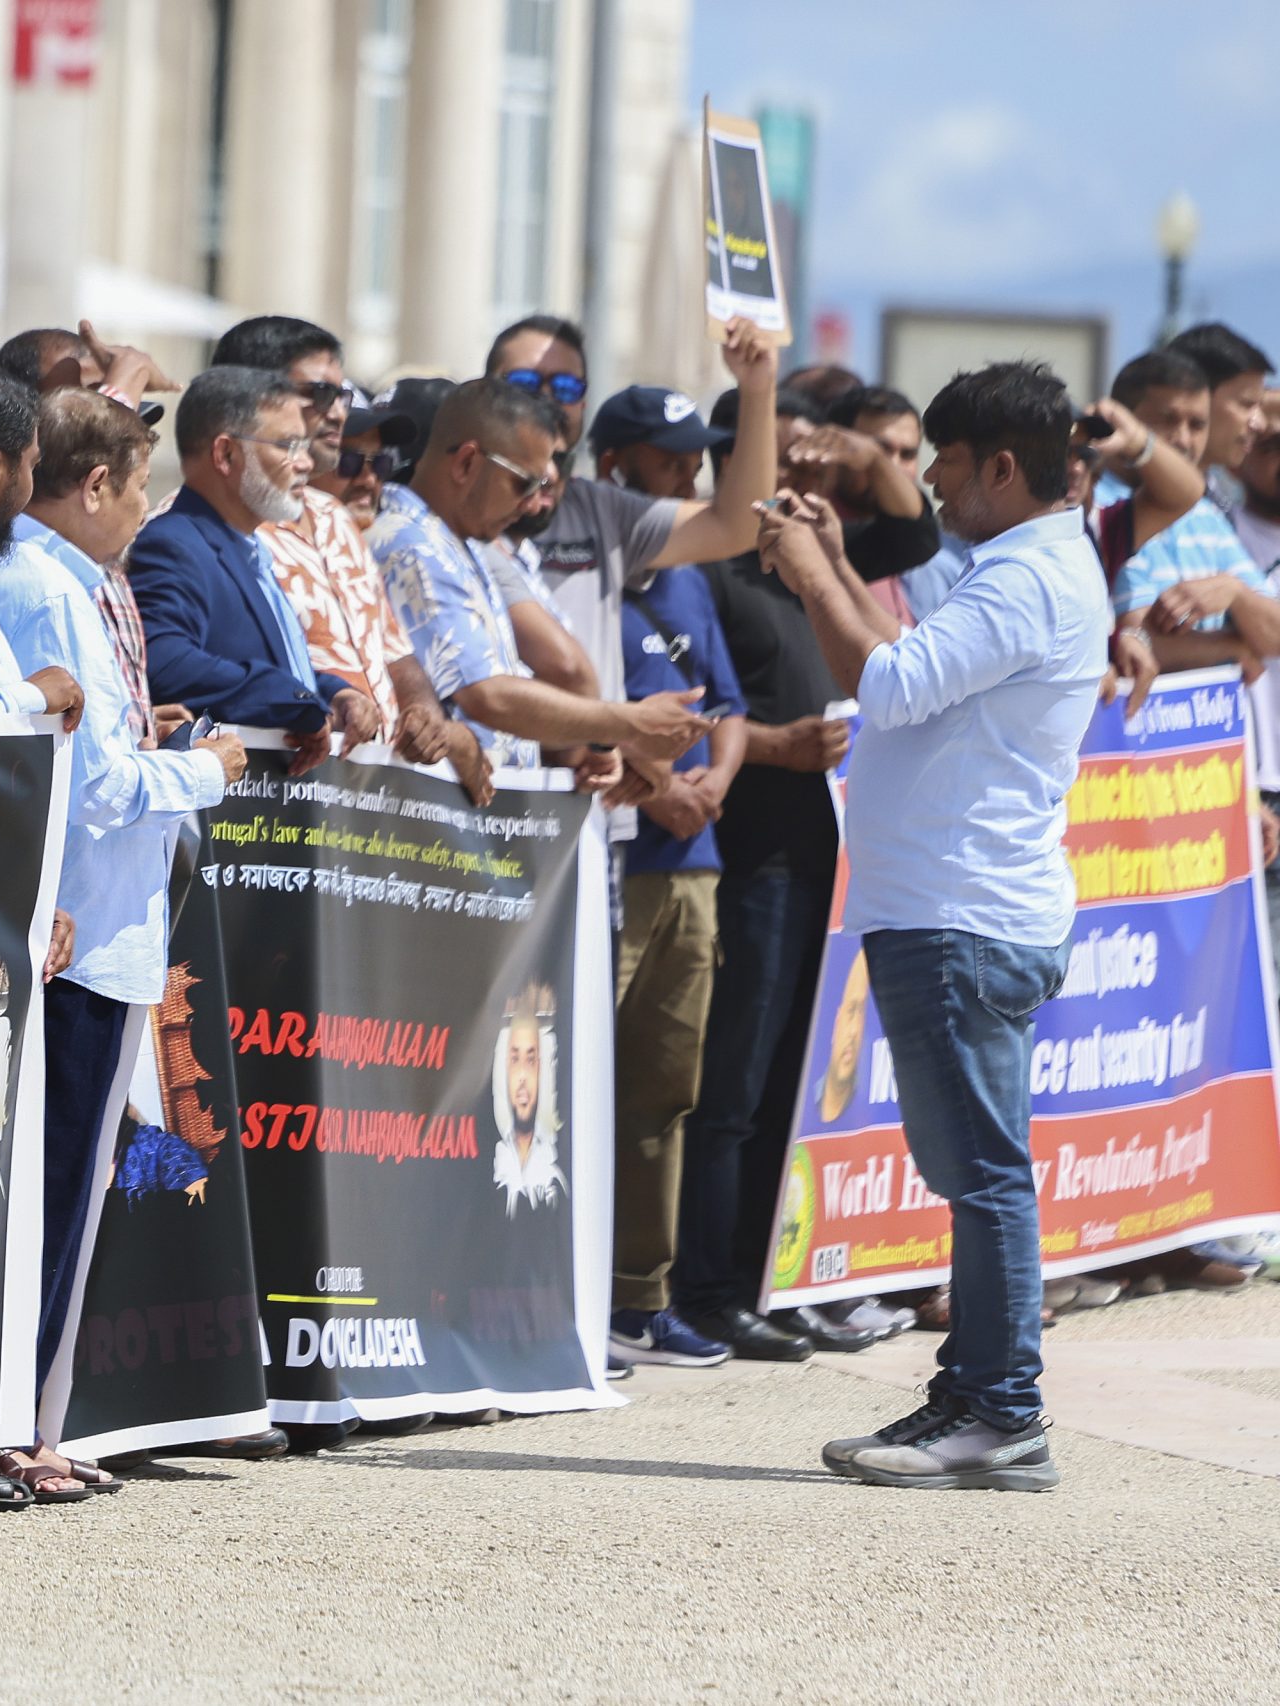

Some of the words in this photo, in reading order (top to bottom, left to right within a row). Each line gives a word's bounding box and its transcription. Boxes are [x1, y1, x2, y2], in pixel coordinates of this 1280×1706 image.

[271, 817, 303, 844] law
[222, 863, 235, 887] ও
[239, 862, 312, 893] সমাজকে
[823, 1153, 895, 1221] World
